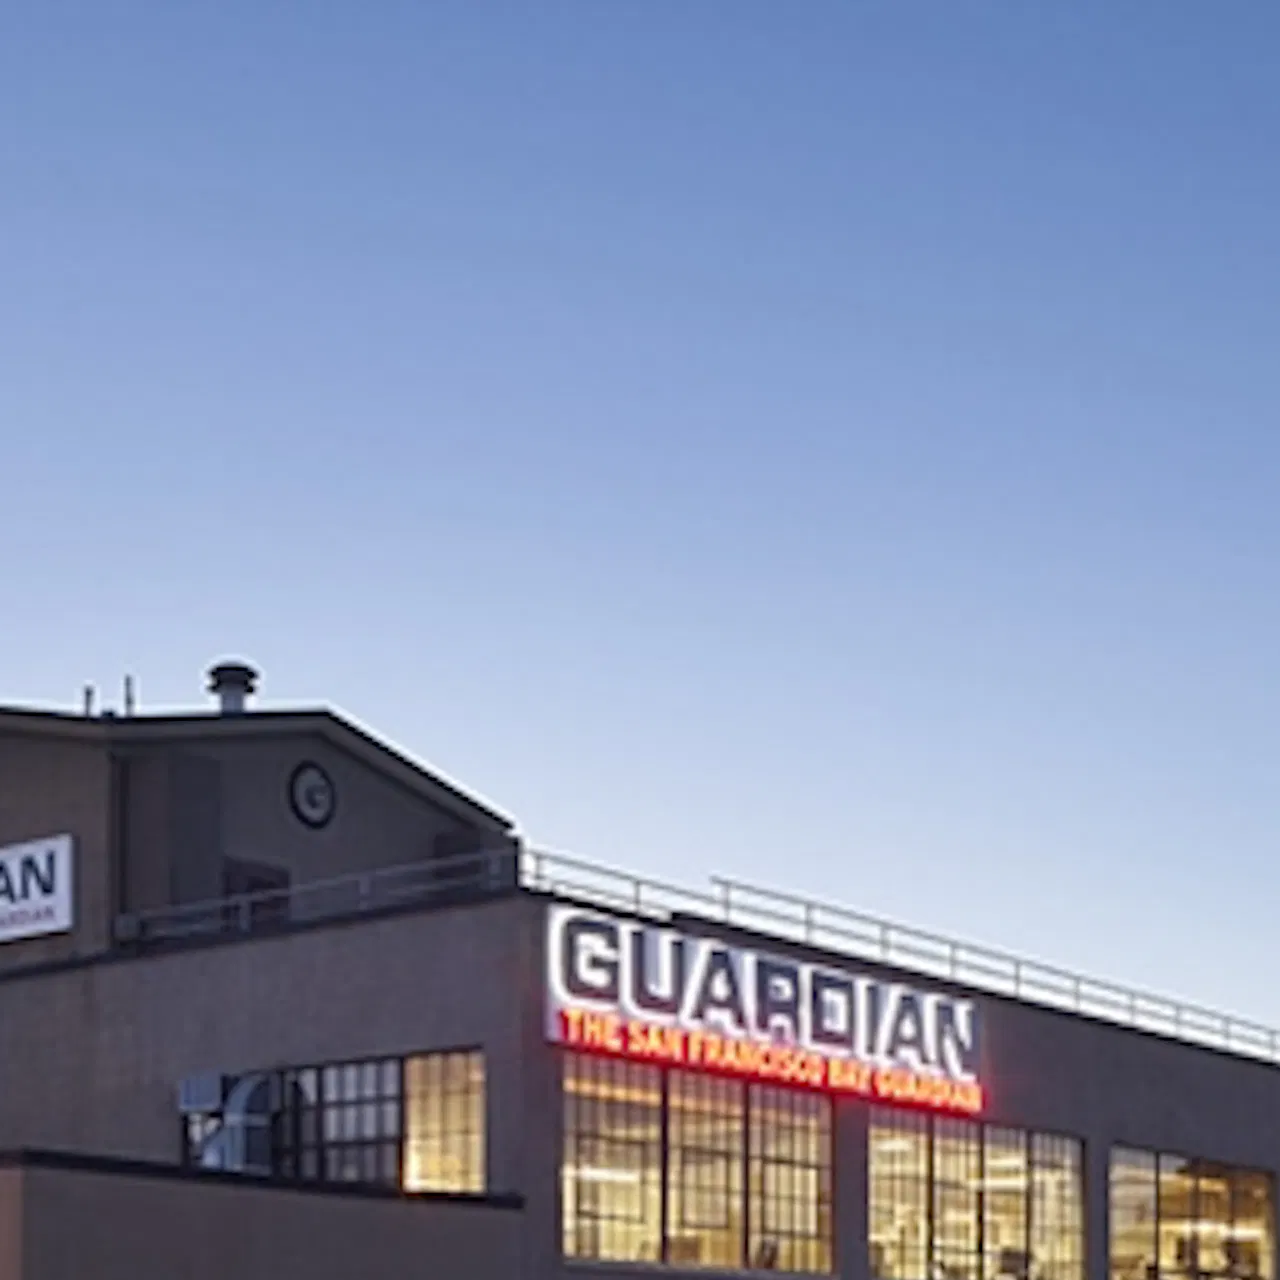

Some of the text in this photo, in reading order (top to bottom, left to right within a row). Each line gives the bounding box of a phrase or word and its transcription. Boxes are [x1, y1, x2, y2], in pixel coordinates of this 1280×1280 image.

[550, 908, 983, 1080] GUARDIAN
[561, 1008, 984, 1114] THE SAN FRANCISCO BAY GUARDIAN
